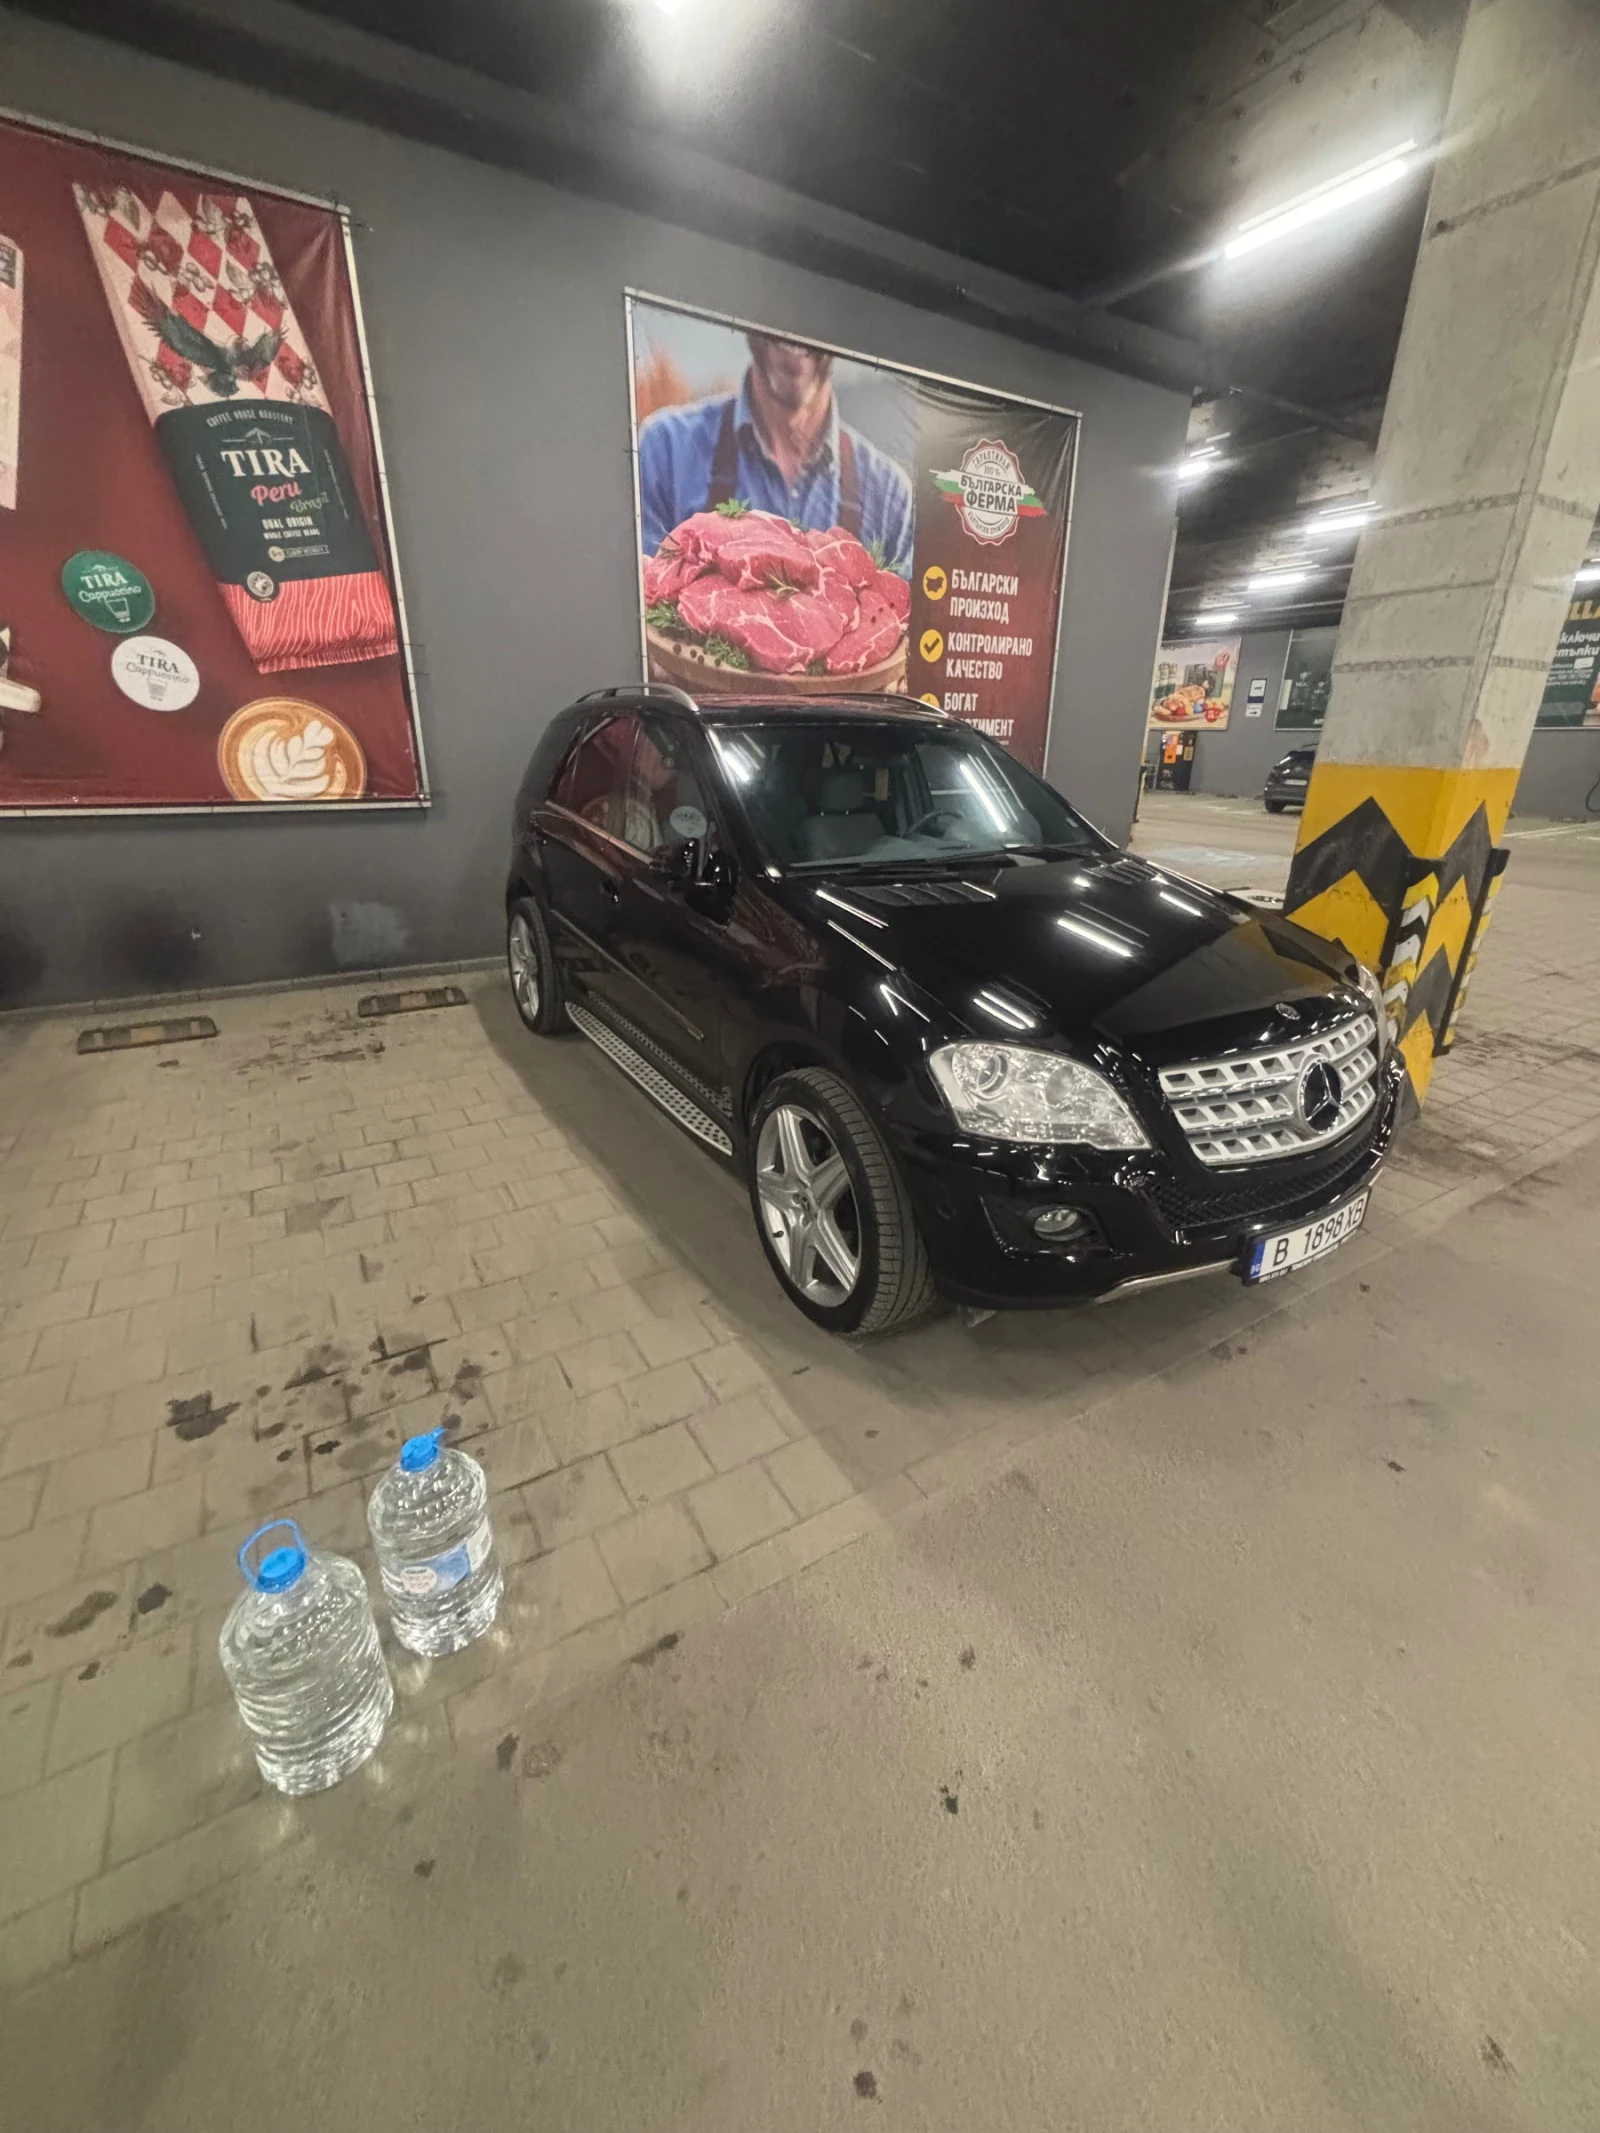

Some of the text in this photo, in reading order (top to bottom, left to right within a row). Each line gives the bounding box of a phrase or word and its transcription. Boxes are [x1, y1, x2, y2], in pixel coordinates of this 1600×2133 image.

[220, 447, 311, 478] TIRA
[251, 481, 303, 507] Peru
[960, 474, 1022, 497] БЪЛГАРСКА
[966, 489, 1016, 512] ФЕРМА
[262, 515, 314, 530] DUAL ORIGIN
[263, 528, 321, 540] WHOLE COFFEE BEANS
[80, 572, 128, 589] TIRA
[951, 568, 1019, 596] БЪЛГАРСКИ
[78, 585, 142, 603] Cappuccino
[949, 596, 1010, 625] ПРОИЗХОД
[947, 631, 1033, 656] КОНТРОЛИРАНО
[125, 661, 190, 684] Cappuccino
[136, 653, 180, 674] TIRA
[945, 658, 1003, 680] КАЧЕСТВО
[944, 692, 979, 711] БОГАТ
[1273, 1237, 1289, 1267] B
[1304, 1211, 1344, 1256] 1898
[1344, 1197, 1365, 1233] XB
[1250, 1264, 1261, 1275] BG
